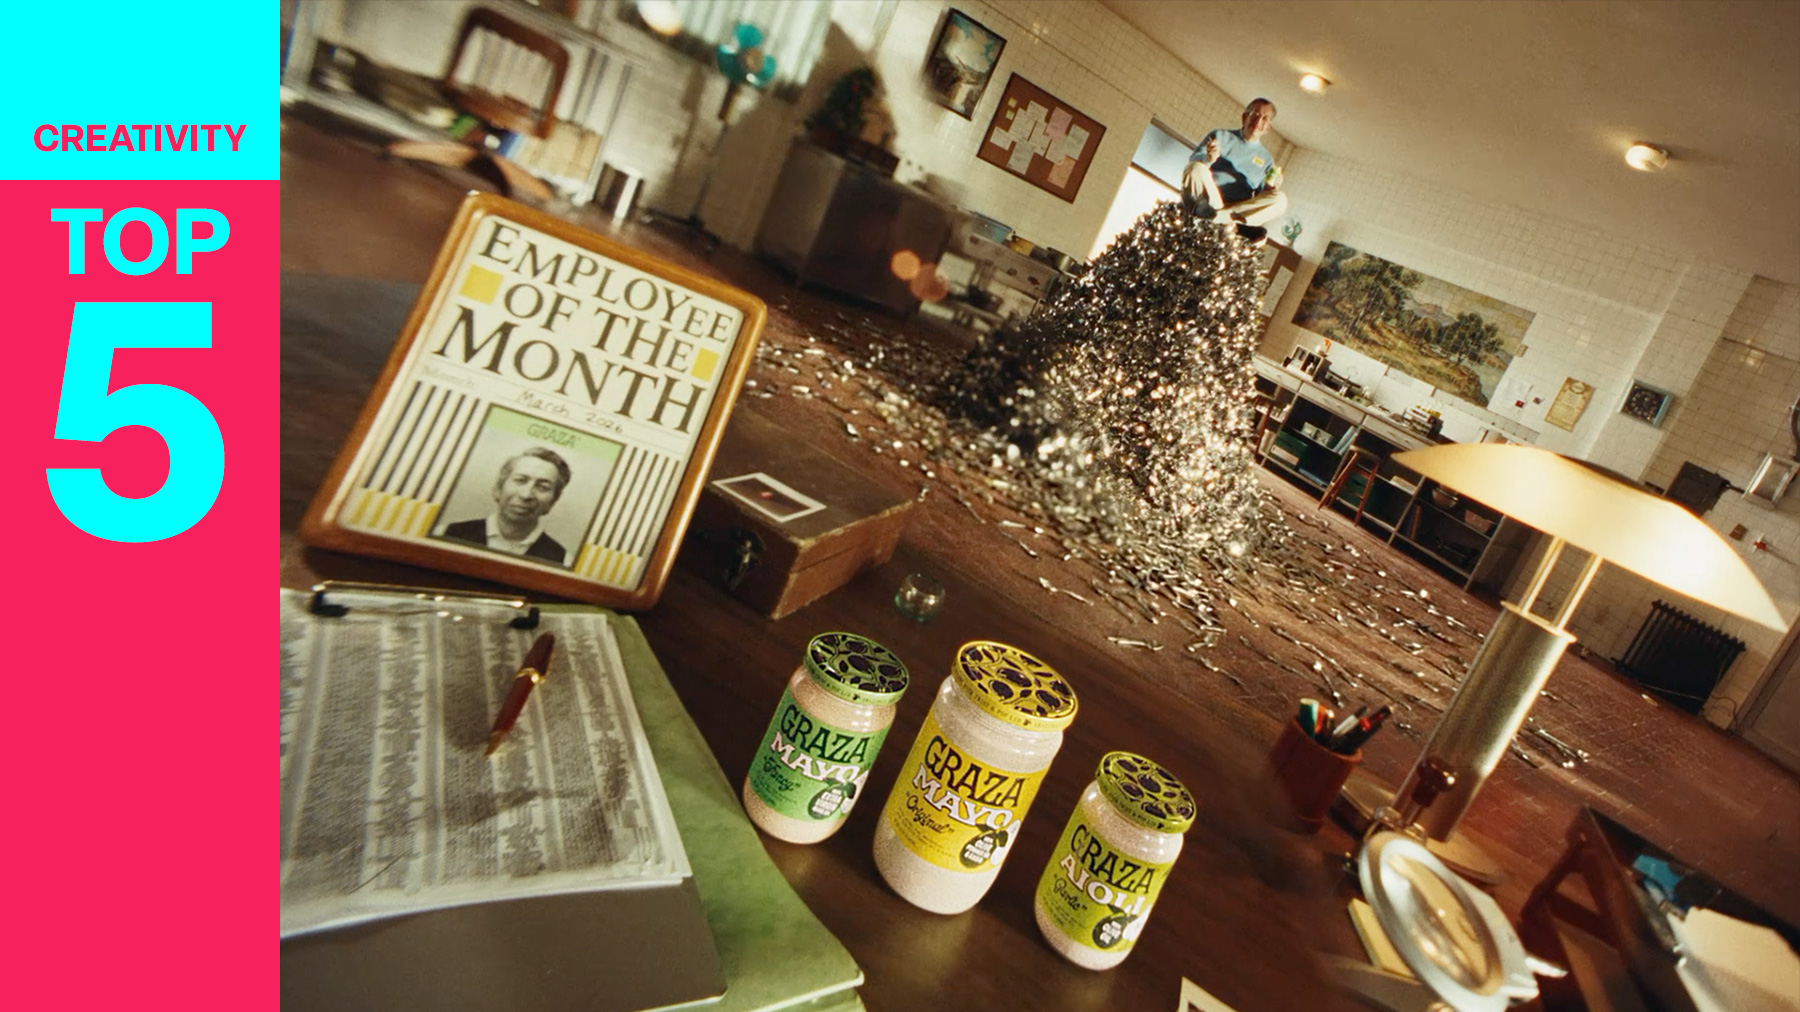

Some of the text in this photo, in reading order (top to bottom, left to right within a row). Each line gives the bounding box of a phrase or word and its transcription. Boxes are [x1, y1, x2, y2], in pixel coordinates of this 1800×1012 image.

[478, 221, 734, 343] EMPLOYEE
[504, 283, 694, 373] OF THE
[431, 304, 707, 434] MONTH
[517, 390, 624, 434] March 2026
[527, 423, 577, 449] GRAZA
[770, 731, 860, 784] MAYO
[781, 703, 871, 763] GRAZA
[912, 764, 1013, 830] MAYO
[924, 735, 1027, 808] GRAZA
[1060, 854, 1146, 915] AIOLI
[1071, 824, 1156, 894] GRAZA
